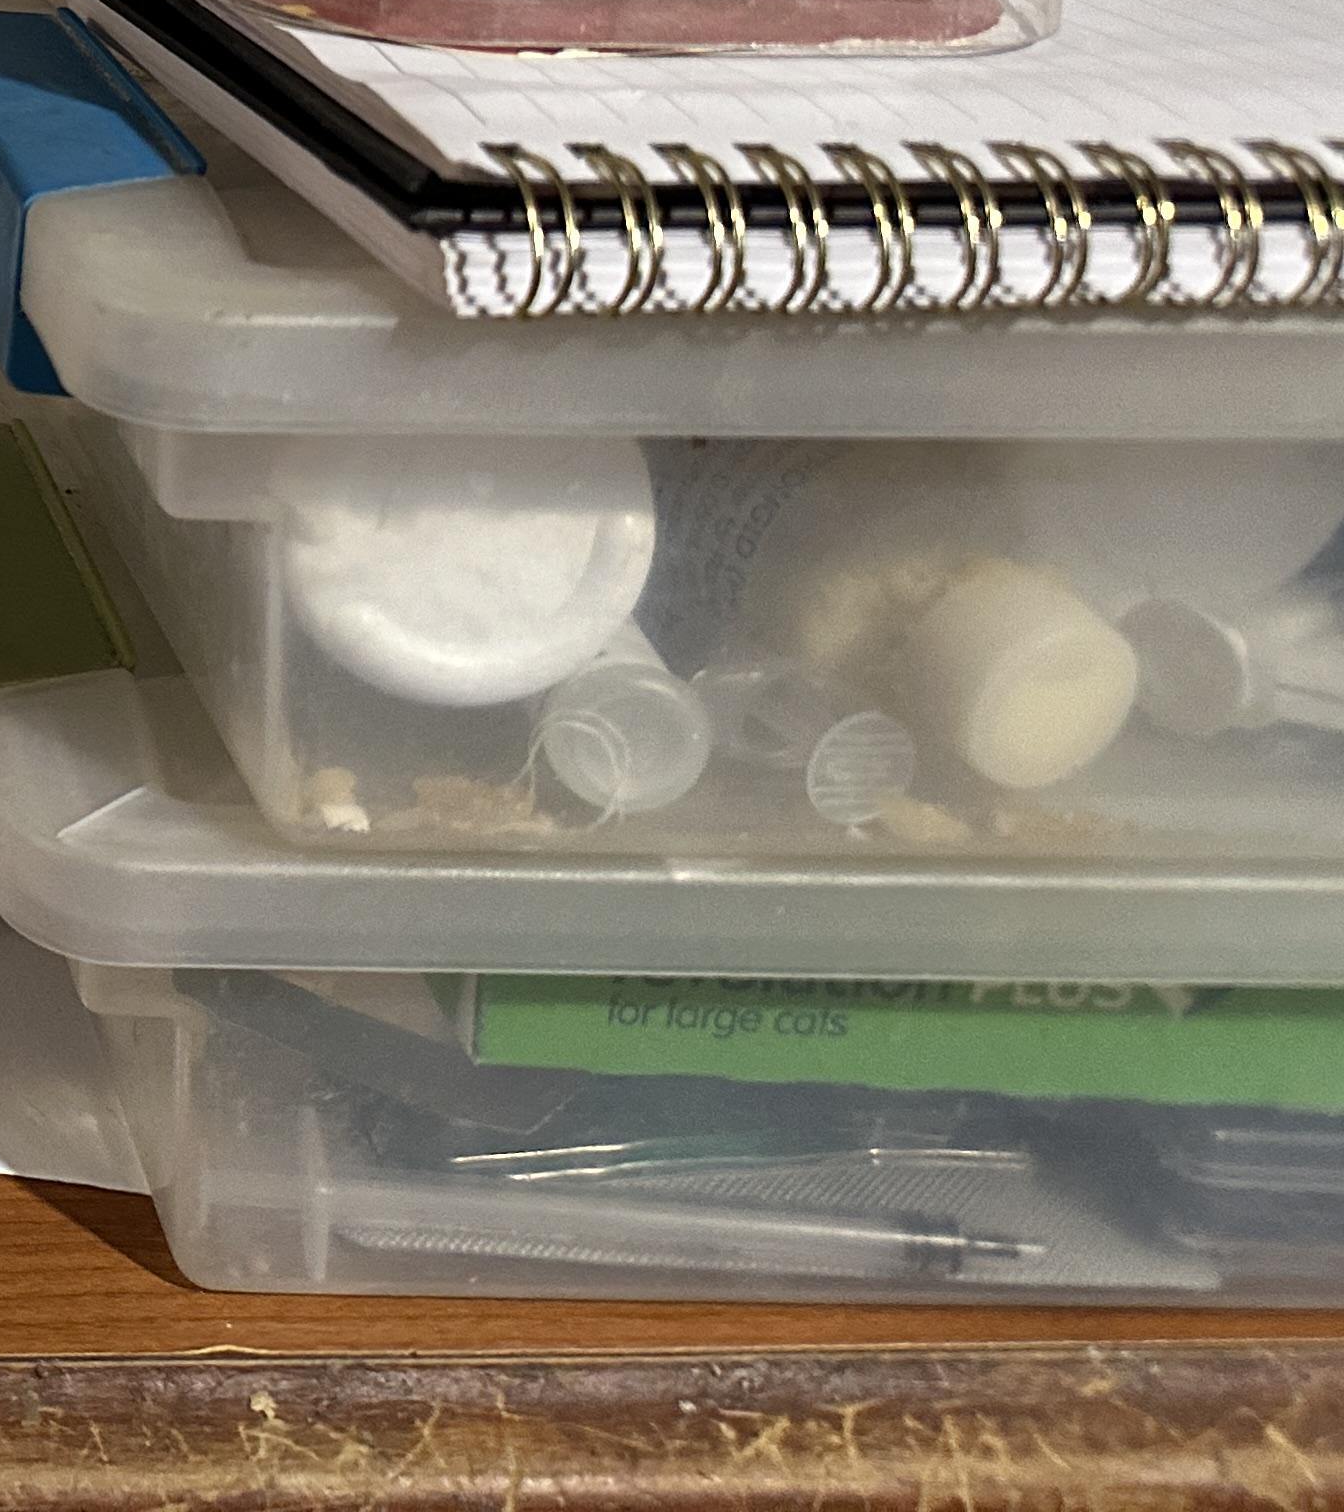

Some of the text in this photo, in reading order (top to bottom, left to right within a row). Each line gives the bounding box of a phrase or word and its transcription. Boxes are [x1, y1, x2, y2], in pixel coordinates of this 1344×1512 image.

[606, 996, 850, 1040] for large cats
